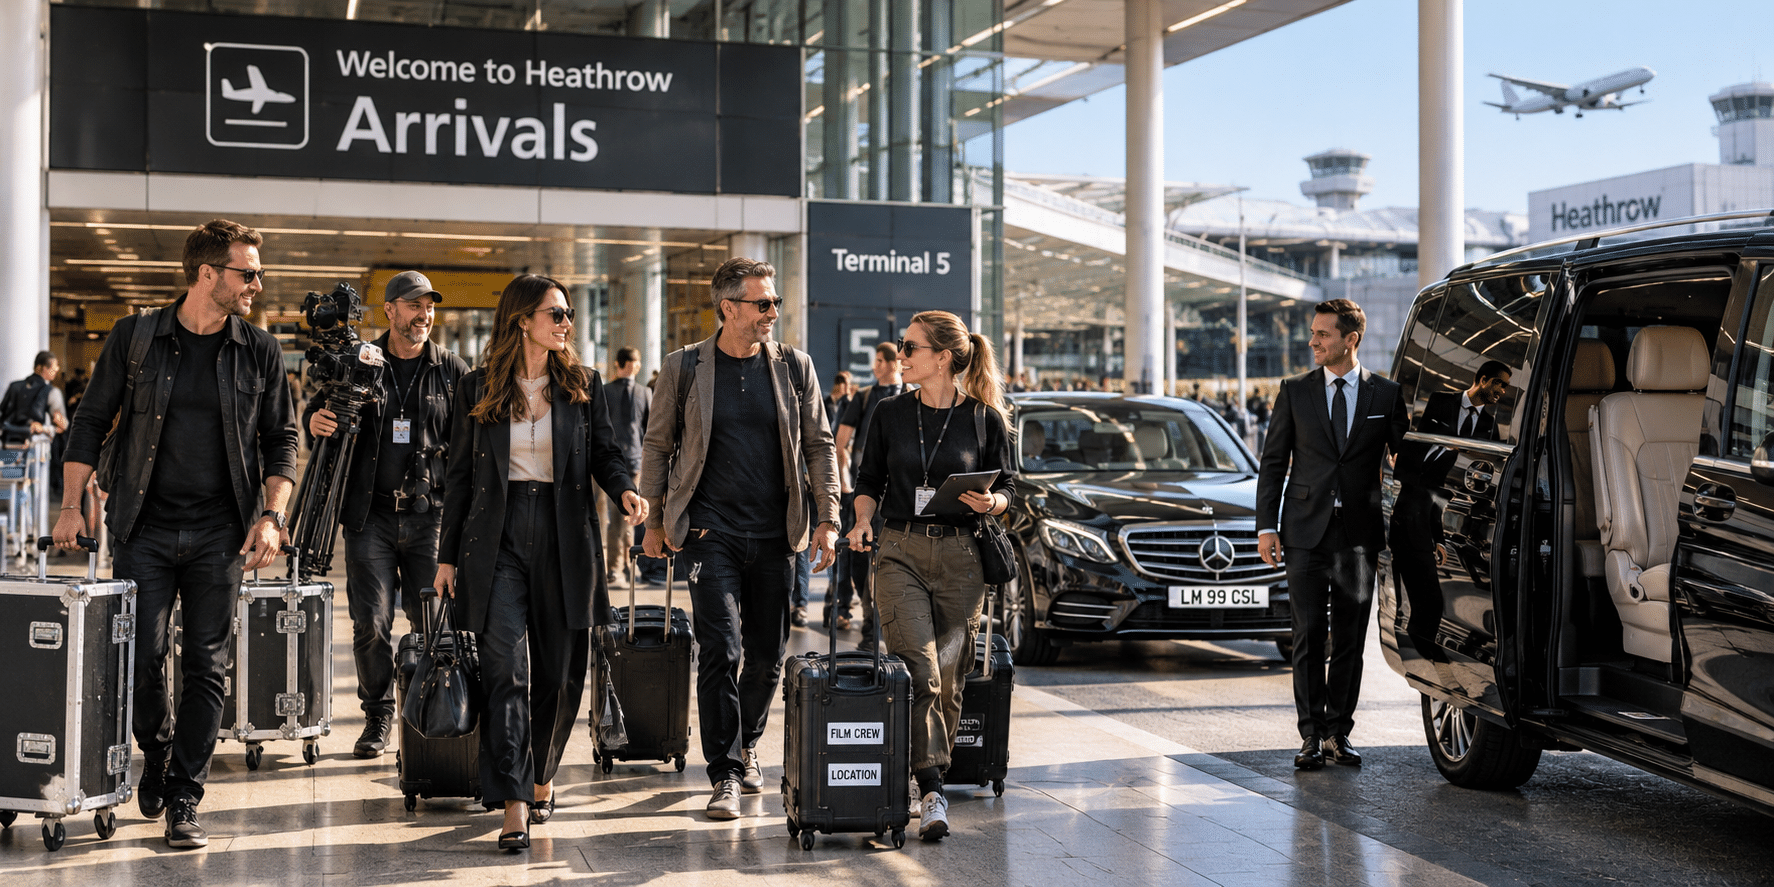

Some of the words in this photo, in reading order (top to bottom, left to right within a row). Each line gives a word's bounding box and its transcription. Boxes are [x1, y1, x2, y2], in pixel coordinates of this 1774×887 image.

[337, 49, 475, 83] Welcome
[484, 59, 515, 85] to
[525, 60, 673, 93] Heathrow
[336, 95, 599, 162] Arrivals
[1551, 194, 1661, 232] Heathrow
[831, 248, 930, 274] Terminal
[936, 252, 951, 275] 5
[850, 328, 879, 383] 5
[1181, 589, 1202, 605] LM
[1207, 589, 1227, 605] 99
[1231, 589, 1260, 605] CSL
[830, 728, 851, 739] FILM
[854, 728, 880, 739] CREW
[831, 769, 877, 780] LOCATION
